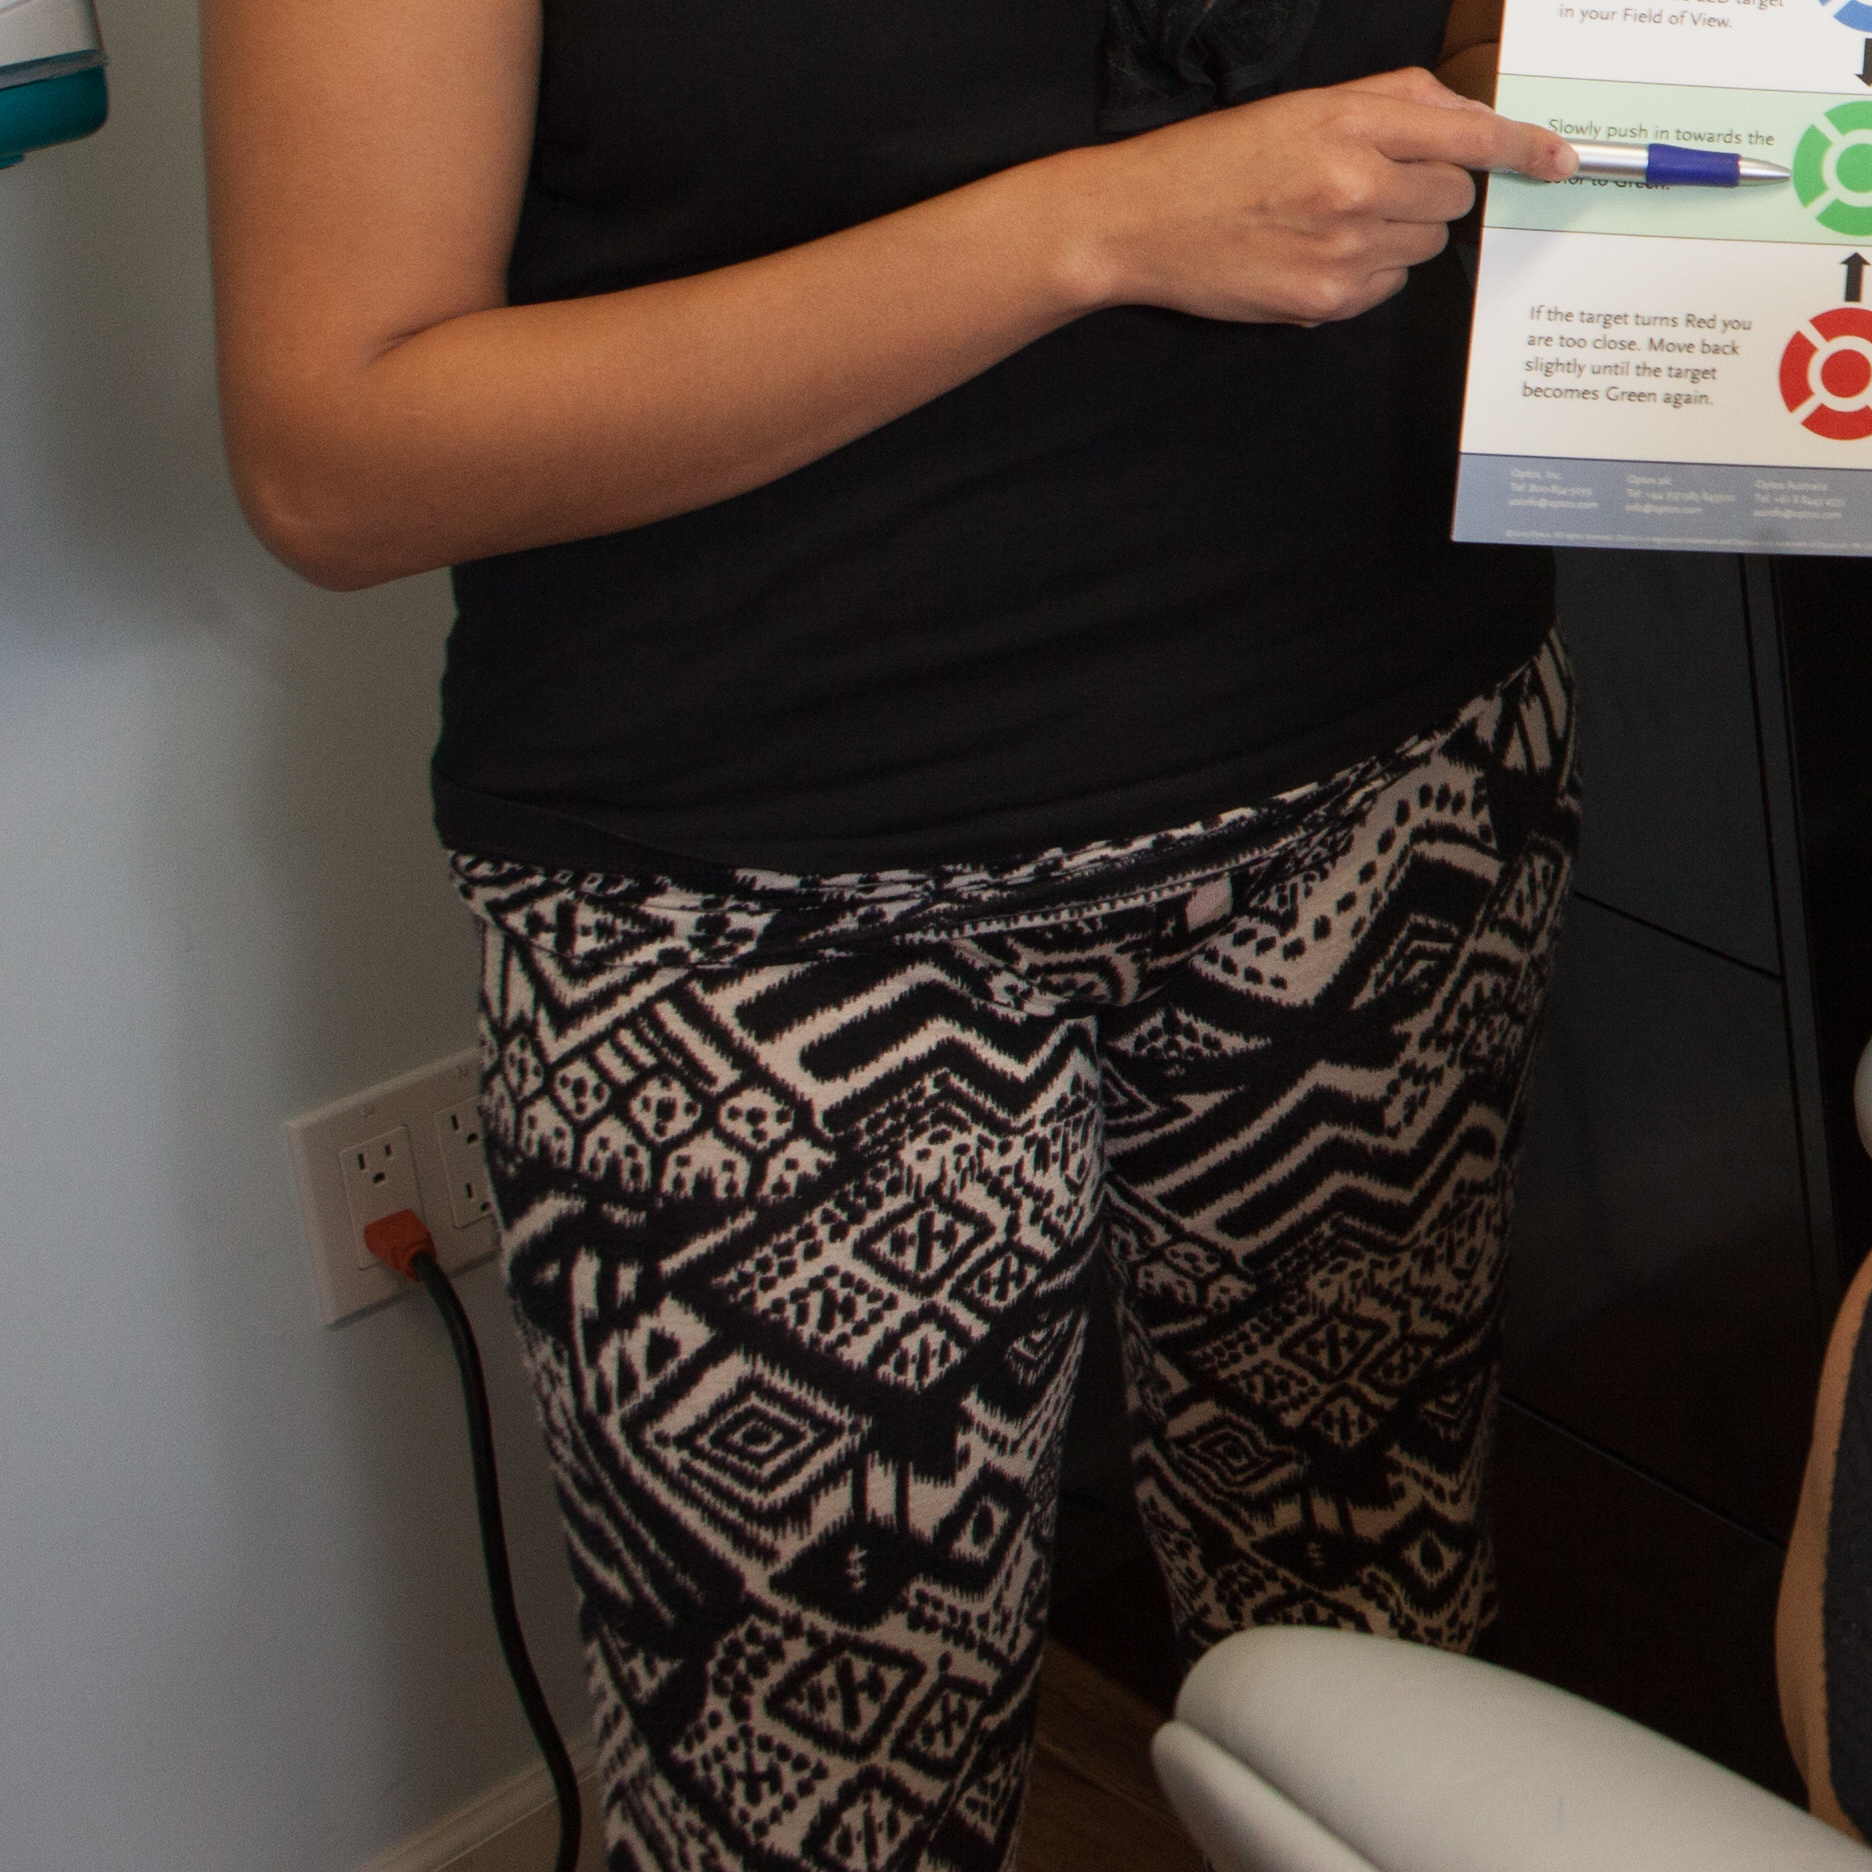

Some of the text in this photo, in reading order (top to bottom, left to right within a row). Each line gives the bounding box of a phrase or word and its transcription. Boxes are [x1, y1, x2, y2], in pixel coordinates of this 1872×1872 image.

[1559, 4, 1732, 28] in your Field of View.
[1548, 119, 1774, 146] Slowly push in towards the
[1530, 305, 1752, 333] If the target turns Red you
[1527, 335, 1740, 355] are too close. Move back
[1525, 358, 1717, 383] slightly until the target
[1523, 382, 1714, 408] becomes Green again.
